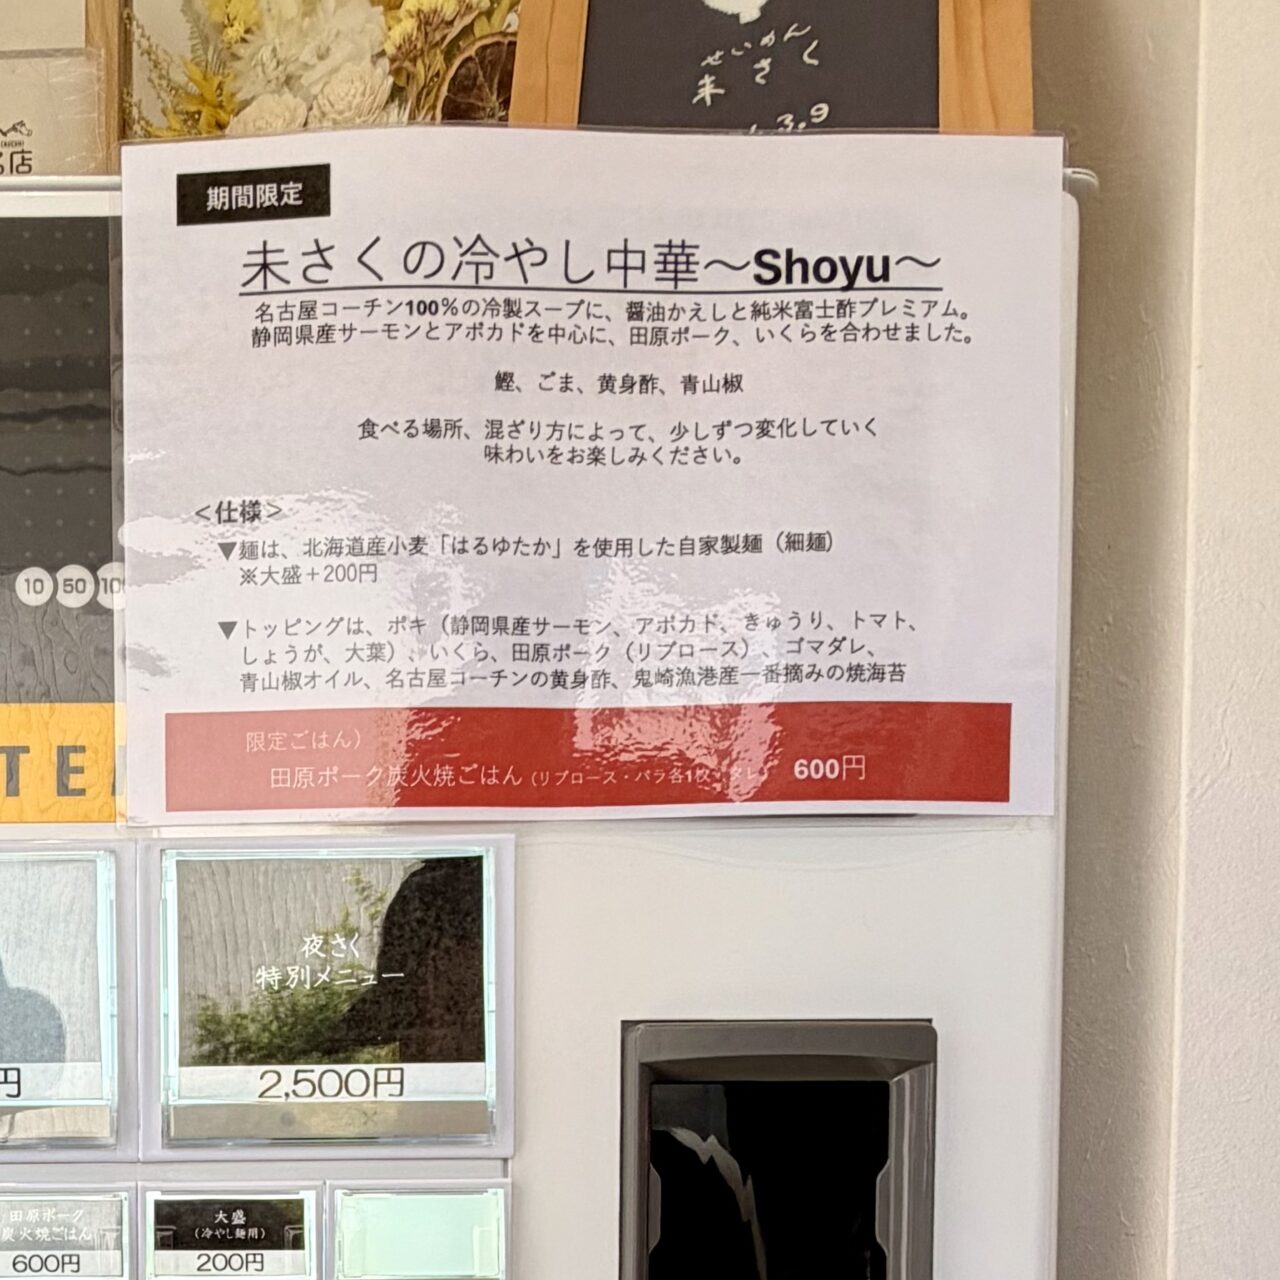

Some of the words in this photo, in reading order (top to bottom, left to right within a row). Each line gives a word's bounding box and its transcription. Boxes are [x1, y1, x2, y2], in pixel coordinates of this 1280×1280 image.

[207, 182, 303, 211] 期間限定
[358, 417, 877, 440] 食べる場所、混ざり方によって、少しずつ変化していく
[484, 445, 741, 465] 味わいをお楽しみください。
[24, 578, 44, 594] 10
[63, 578, 86, 594] 50
[794, 755, 866, 781] 600円
[301, 933, 360, 958] 夜さく
[256, 965, 404, 988] 特別メニュー
[257, 1067, 404, 1101] 2,500円
[214, 1209, 247, 1224] 大盛
[12, 1253, 81, 1273] 600円
[197, 1252, 265, 1273] 200円
